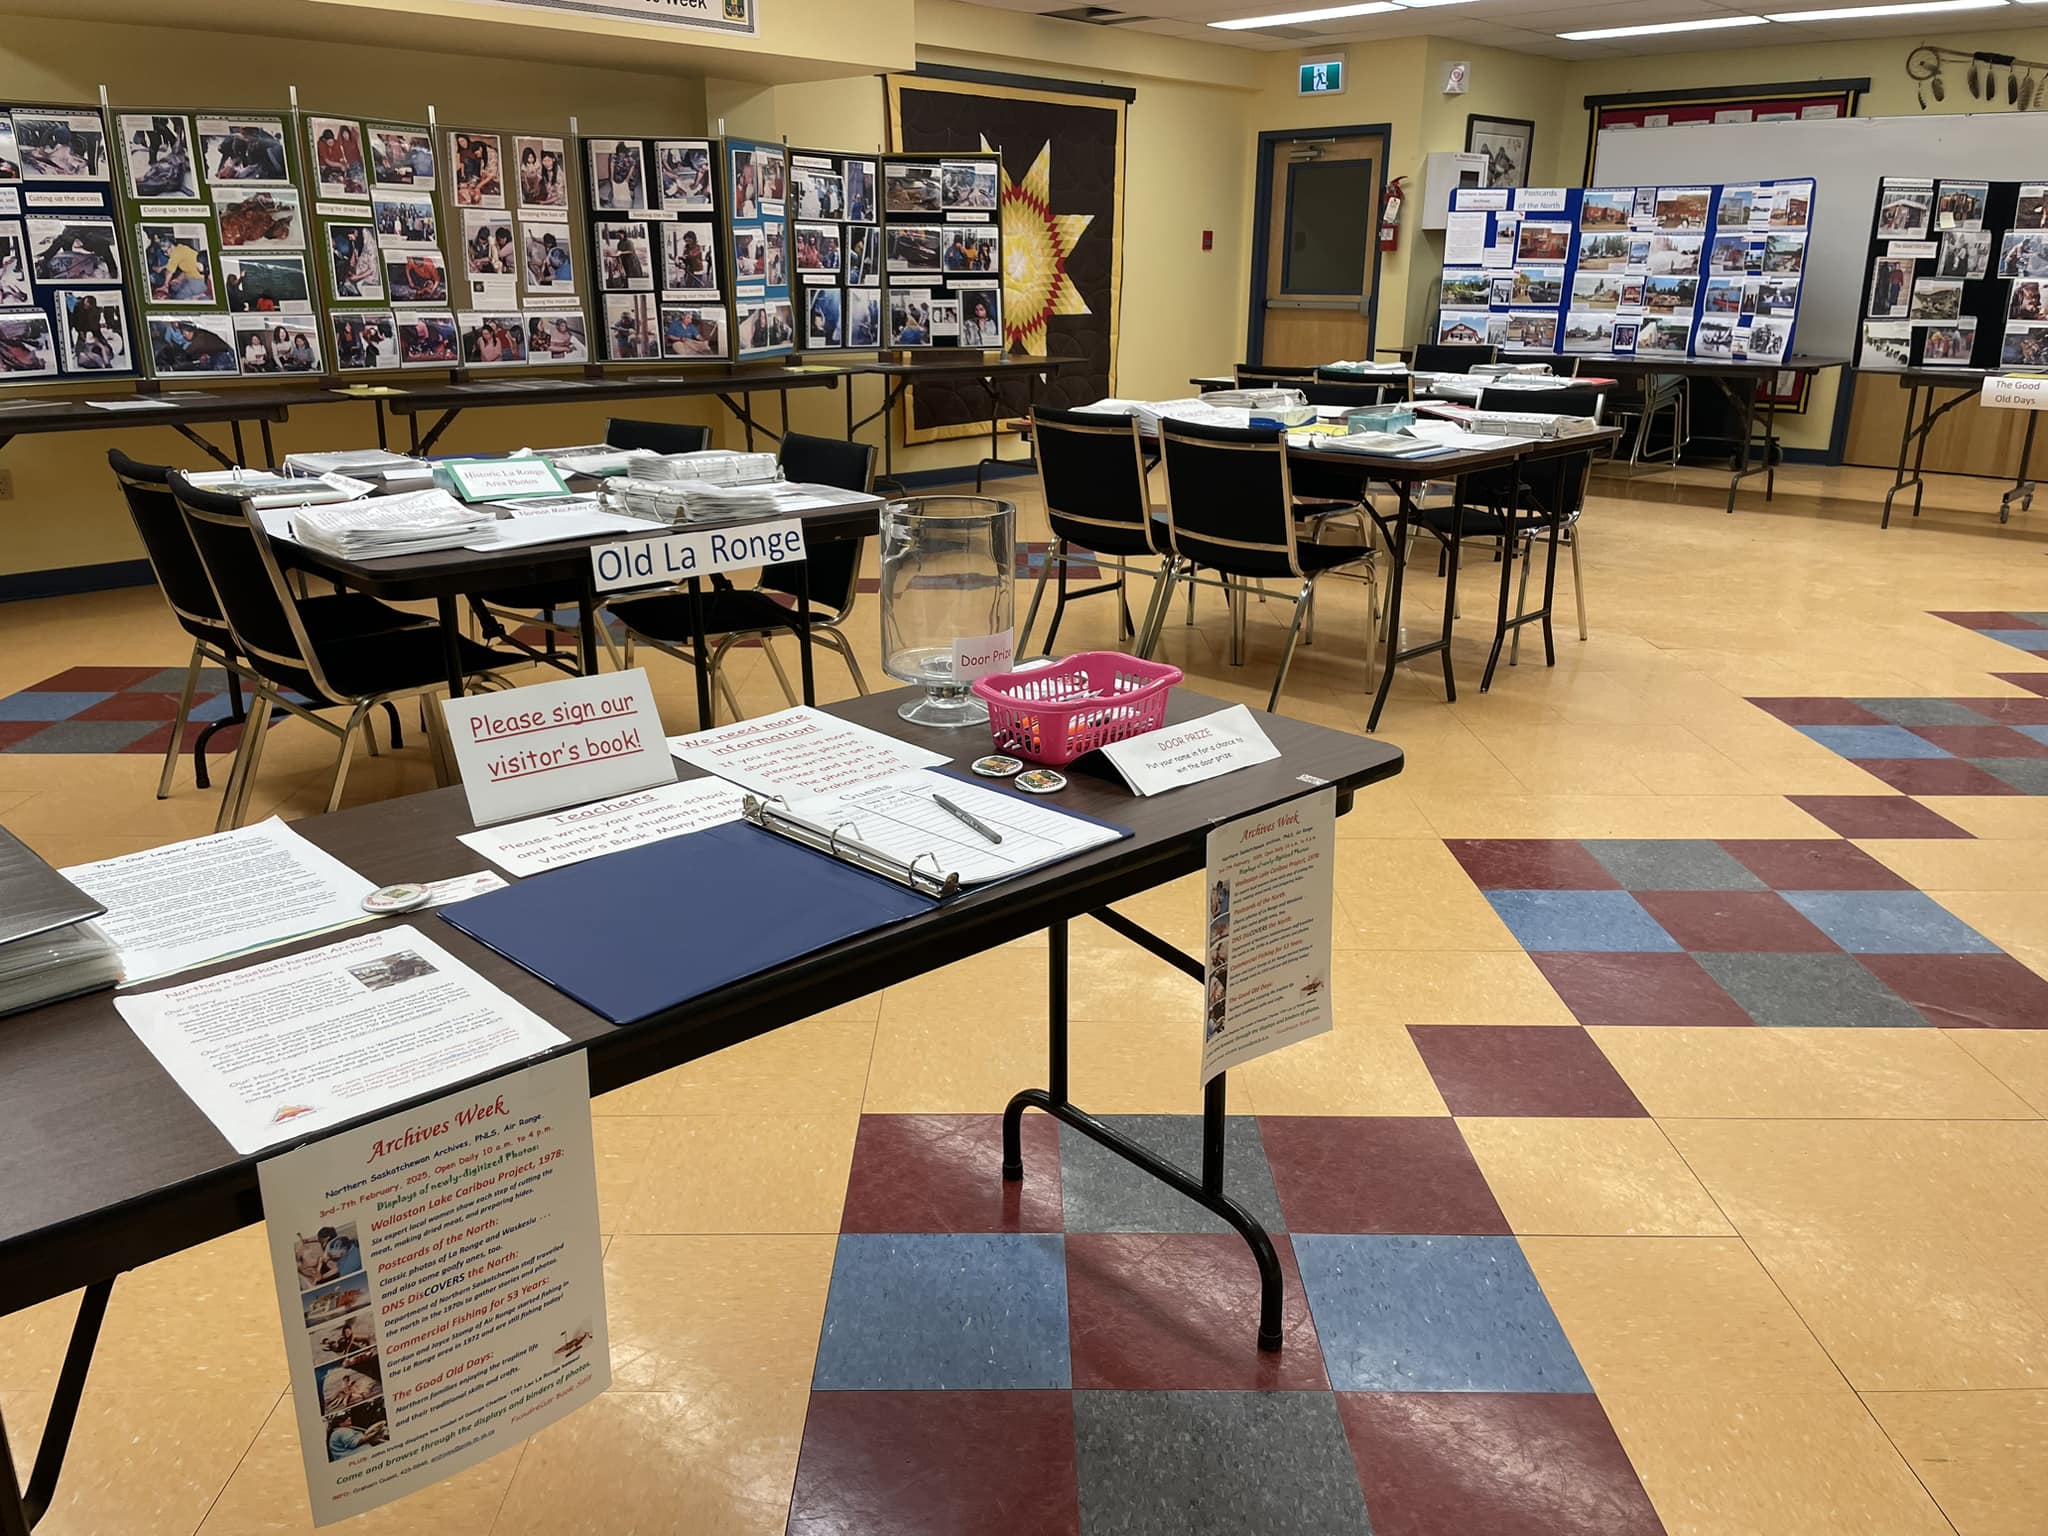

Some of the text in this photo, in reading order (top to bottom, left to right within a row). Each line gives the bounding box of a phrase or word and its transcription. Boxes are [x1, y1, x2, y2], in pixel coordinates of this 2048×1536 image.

[1524, 189, 1558, 197] Postcards
[1995, 394, 2036, 405] Old Days
[1996, 380, 2041, 390] The Good
[464, 470, 500, 479] Historic
[485, 477, 539, 488] Area Photos
[598, 530, 801, 581] Old La Ronge
[961, 655, 991, 667] Door
[470, 695, 634, 738] Please sign our
[676, 714, 811, 750] We need more
[488, 728, 643, 777] visitor's book!
[707, 724, 820, 757] information!
[1145, 762, 1160, 770] Put
[1158, 758, 1173, 768] your
[1173, 753, 1192, 762] name
[1197, 747, 1209, 756] for
[1214, 739, 1237, 750] chance
[1156, 727, 1214, 752] DOOR PRIZE
[1176, 752, 1233, 774] win the door prize
[546, 794, 659, 824] Teachers
[840, 784, 893, 801] Guests
[498, 835, 553, 852] Please
[554, 824, 599, 838] write
[599, 814, 634, 828] your
[516, 847, 547, 859] and
[549, 832, 609, 851] number
[613, 825, 630, 835] of
[634, 808, 700, 829] students
[718, 798, 741, 807] the
[537, 843, 608, 864] Visitor's
[655, 820, 696, 835] Many
[1239, 809, 1301, 844] Archives Week
[164, 935, 383, 999] Northern Saskatchewan Archives
[366, 1094, 510, 1164] Archives Week
[319, 1125, 554, 1219] 3rd-7th February, 2025, Open Daily 10 a.m. to 4 p.m.
[325, 1179, 368, 1200] Northern
[370, 1155, 431, 1183] Saskatchewan
[433, 1140, 472, 1159] Archives,
[474, 1128, 501, 1143] PNLS,
[503, 1123, 517, 1133] Air
[376, 1144, 540, 1212] Displays of newly-digitized Photos:
[370, 1148, 565, 1232] Wollaston Lake Caribou Project, 1978:
[377, 1218, 499, 1274] Postcards of the North:
[379, 1216, 537, 1288] Classic photos of La Ronge and Waskesiu
[381, 1285, 398, 1300] and
[399, 1280, 417, 1293] also
[417, 1270, 441, 1285] some
[465, 1251, 487, 1264] ones,
[487, 1244, 504, 1255] too.
[381, 1250, 519, 1316] DNS DisCOVERS the North:
[385, 1320, 450, 1356] Commercial
[451, 1305, 488, 1328] Fishing
[489, 1297, 505, 1312] for
[506, 1289, 519, 1303] 53
[392, 1351, 494, 1402] The Good Old Days:
[336, 1471, 364, 1486] Come
[365, 1461, 384, 1475] and
[385, 1448, 419, 1467] browse
[420, 1431, 456, 1453] through
[457, 1424, 472, 1436] the
[473, 1406, 507, 1428] displays
[508, 1396, 525, 1411] and
[525, 1382, 555, 1403] binders
[555, 1374, 565, 1385] of
